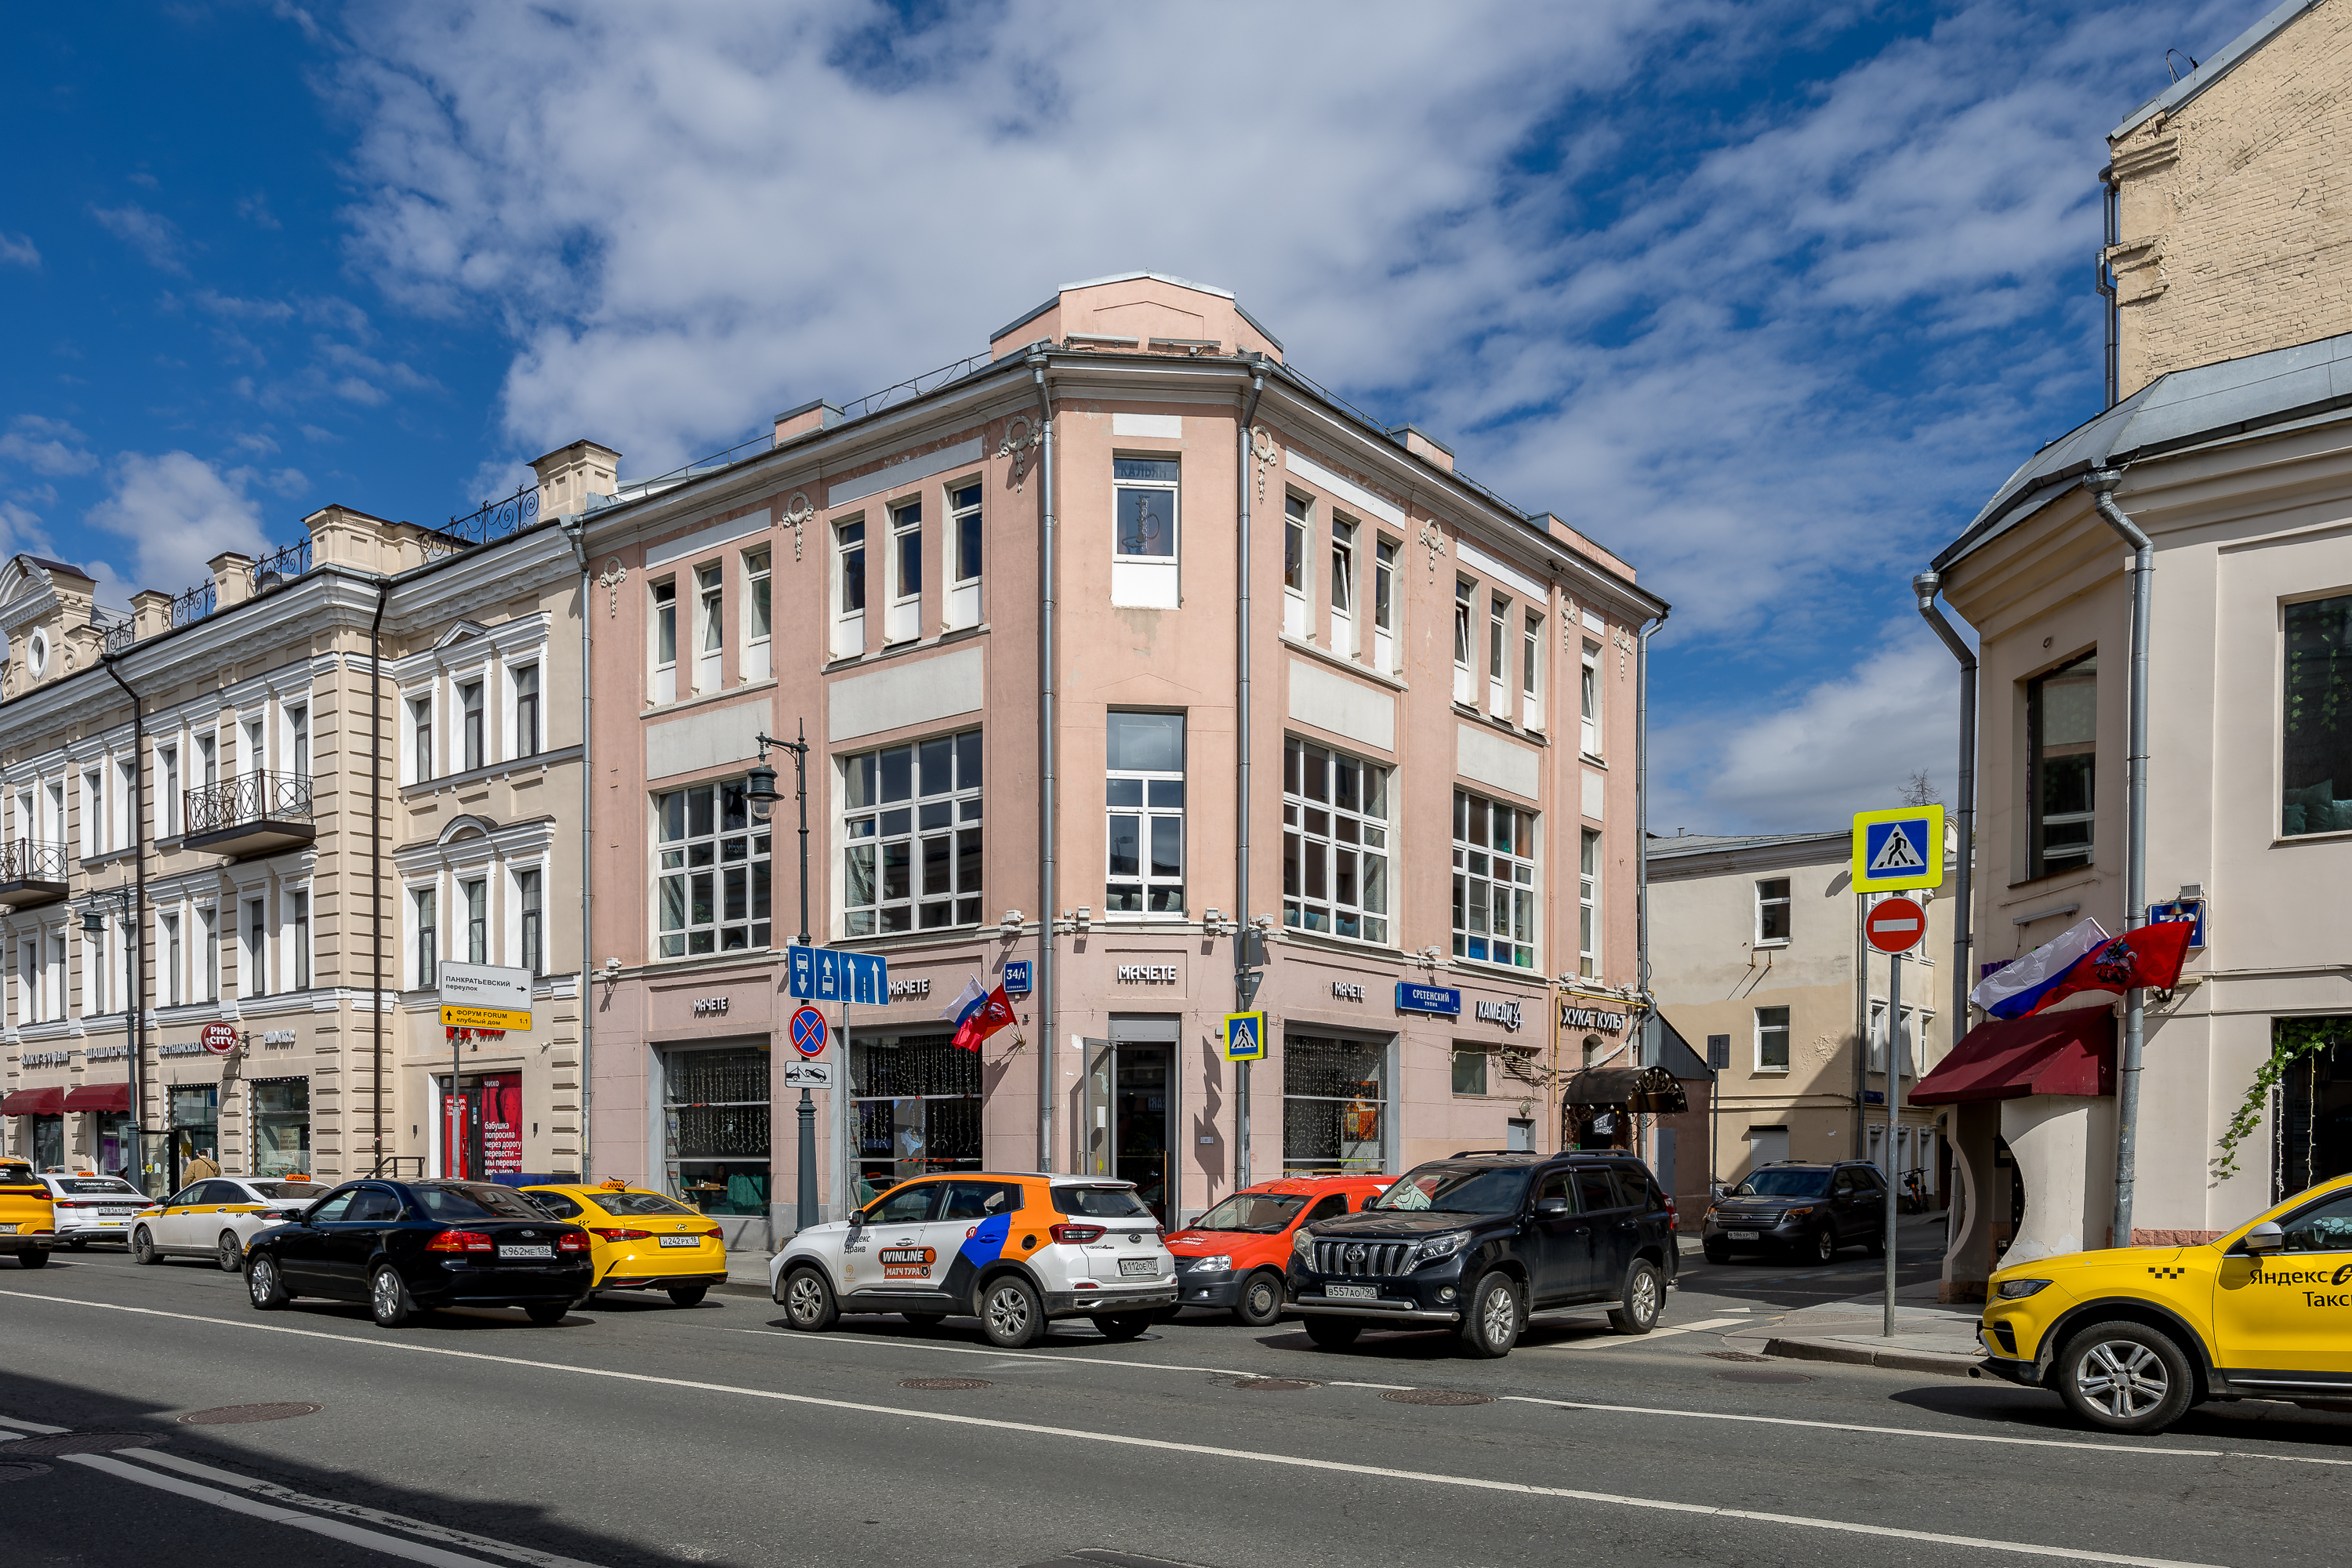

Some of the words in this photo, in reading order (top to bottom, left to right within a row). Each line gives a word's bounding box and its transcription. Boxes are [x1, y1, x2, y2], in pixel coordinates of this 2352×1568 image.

[1120, 463, 1167, 478] КАЛЬЯН
[1007, 967, 1025, 981] 34/1
[1118, 964, 1177, 980] МАЧЕТЕ
[445, 975, 510, 988] ПАНКРАТЬЕВСКИЙ
[888, 978, 928, 996] МАЧЕТЕ
[1335, 981, 1366, 998] МАЧЕТЕ
[1412, 989, 1450, 1003] СРЕТЕНСКИЙ
[694, 996, 727, 1011] МАЧЕТЕ
[1478, 1000, 1513, 1023] КАМЕДИ
[1597, 1011, 1626, 1029] КУЛЬТ
[210, 1026, 231, 1036] PHO
[209, 1036, 233, 1045] CITY
[485, 1121, 510, 1131] бабушка
[502, 1142, 521, 1150] дорогу
[495, 1160, 522, 1168] перевезл
[847, 1234, 871, 1243] Яндекс
[883, 1250, 924, 1262] WINLINE
[886, 1268, 904, 1276] МАТЧ
[904, 1267, 920, 1276] ТУРА
[2249, 1269, 2328, 1287] Яндекс
[2302, 1291, 2352, 1307] Такс
